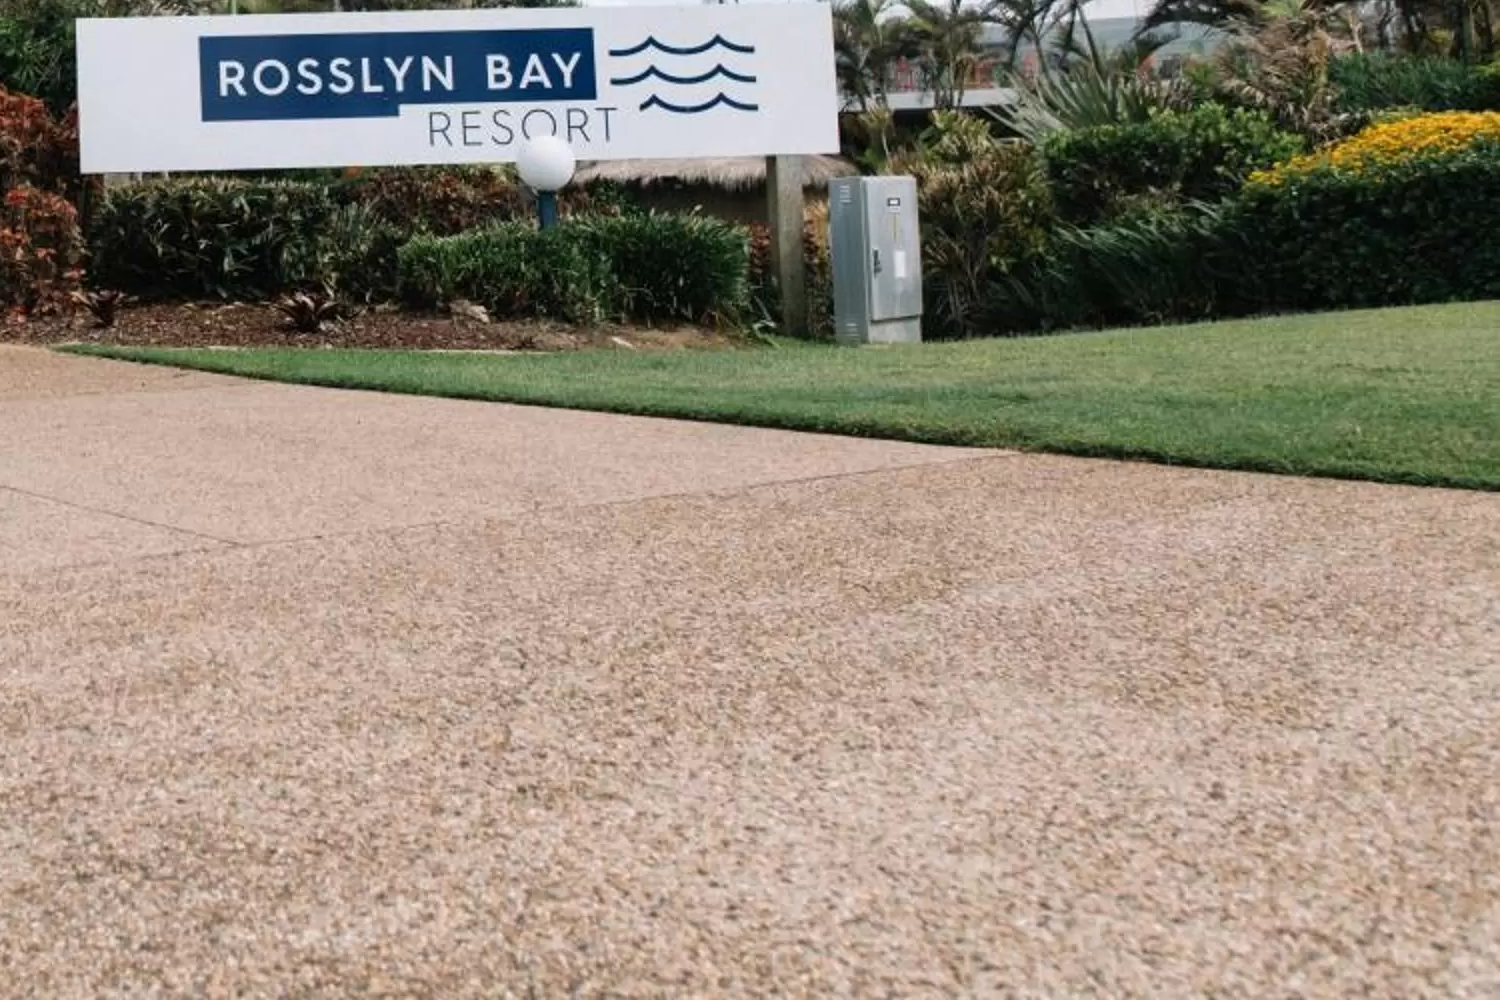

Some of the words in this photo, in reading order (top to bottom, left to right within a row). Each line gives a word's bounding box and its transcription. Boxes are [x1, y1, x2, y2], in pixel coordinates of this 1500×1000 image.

[219, 55, 454, 95] ROSSLYN
[486, 52, 581, 90] BAY
[428, 107, 618, 147] RESORT
